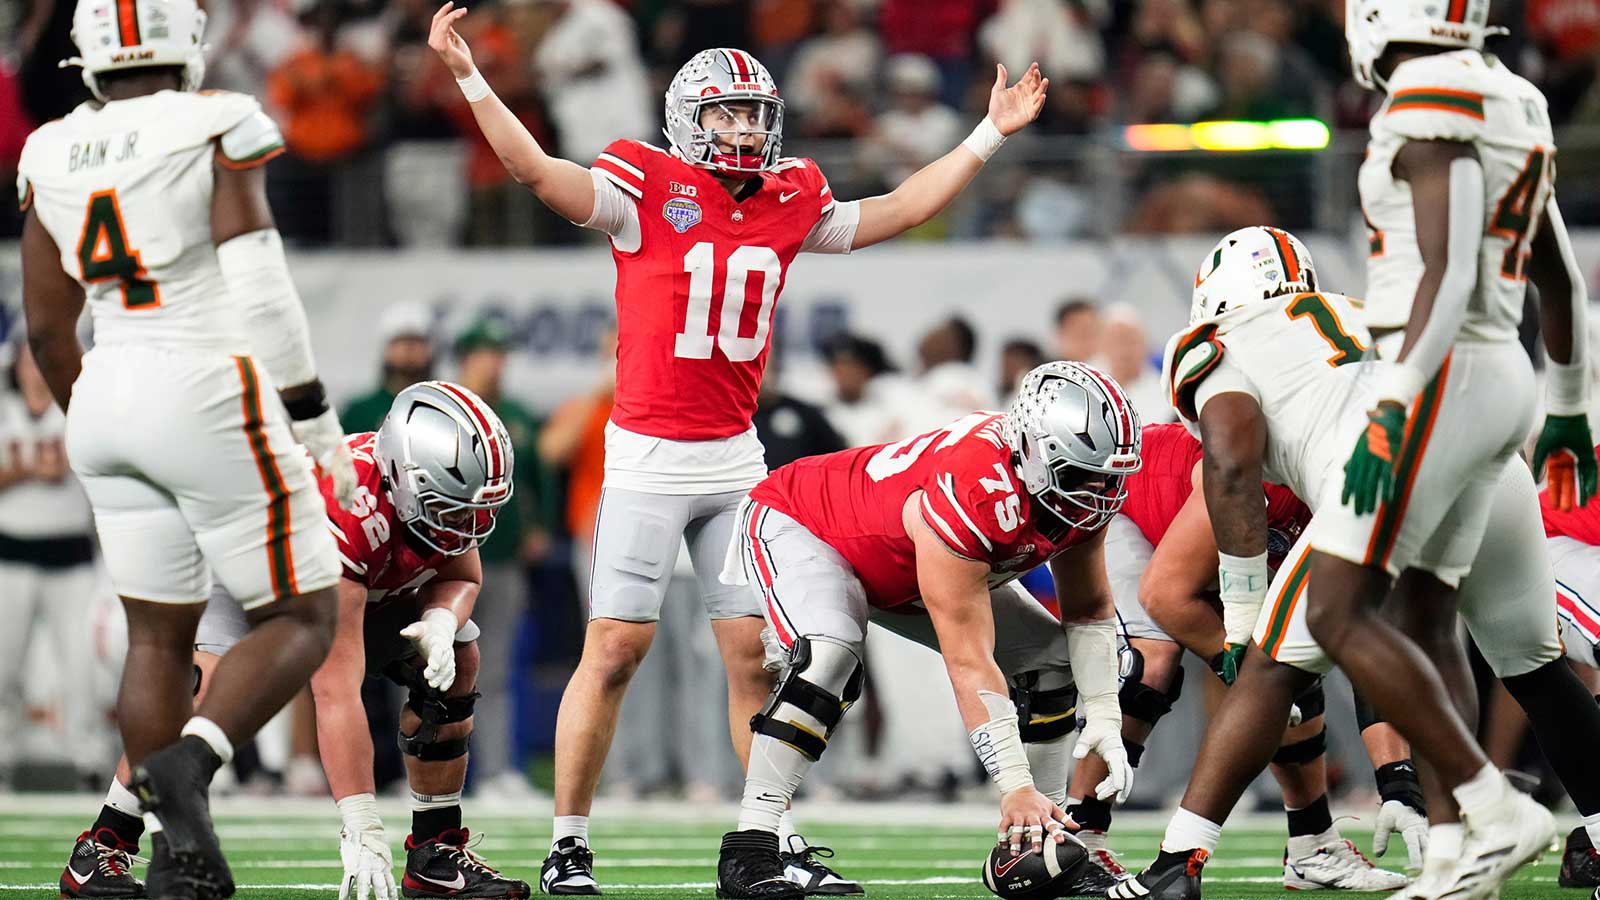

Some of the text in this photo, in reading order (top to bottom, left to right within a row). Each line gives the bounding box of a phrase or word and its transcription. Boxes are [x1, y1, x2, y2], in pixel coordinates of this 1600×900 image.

[68, 139, 109, 172] BAIN
[75, 187, 161, 310] 4
[674, 241, 781, 362] 10
[351, 485, 390, 552] 62
[978, 463, 1026, 532] 75
